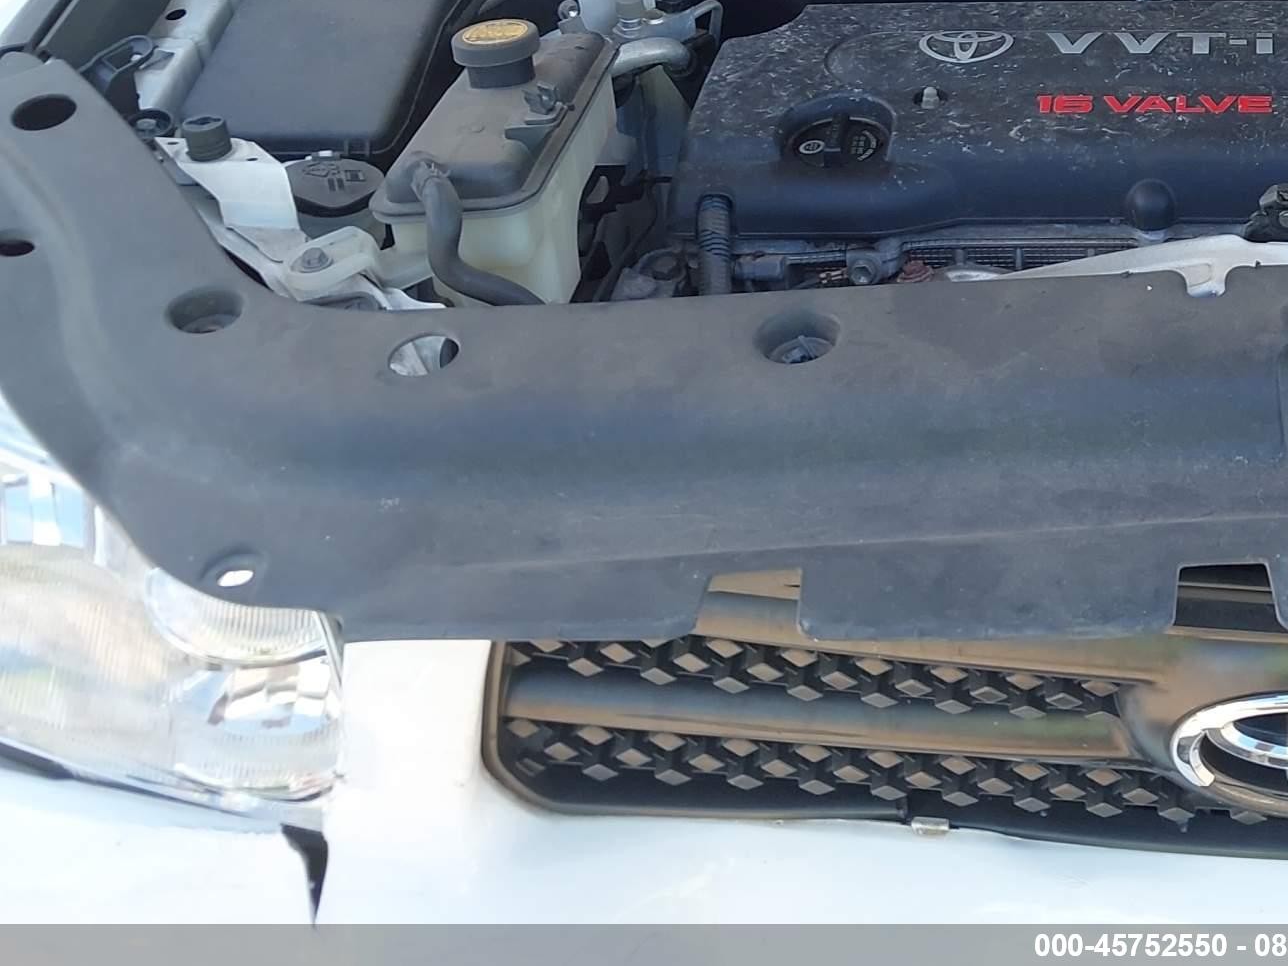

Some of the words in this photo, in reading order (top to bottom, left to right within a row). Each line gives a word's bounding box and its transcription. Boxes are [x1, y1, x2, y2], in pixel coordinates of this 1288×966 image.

[1047, 32, 1274, 54] VVT-i
[1037, 94, 1094, 113] 16
[1103, 94, 1274, 114] VALVE
